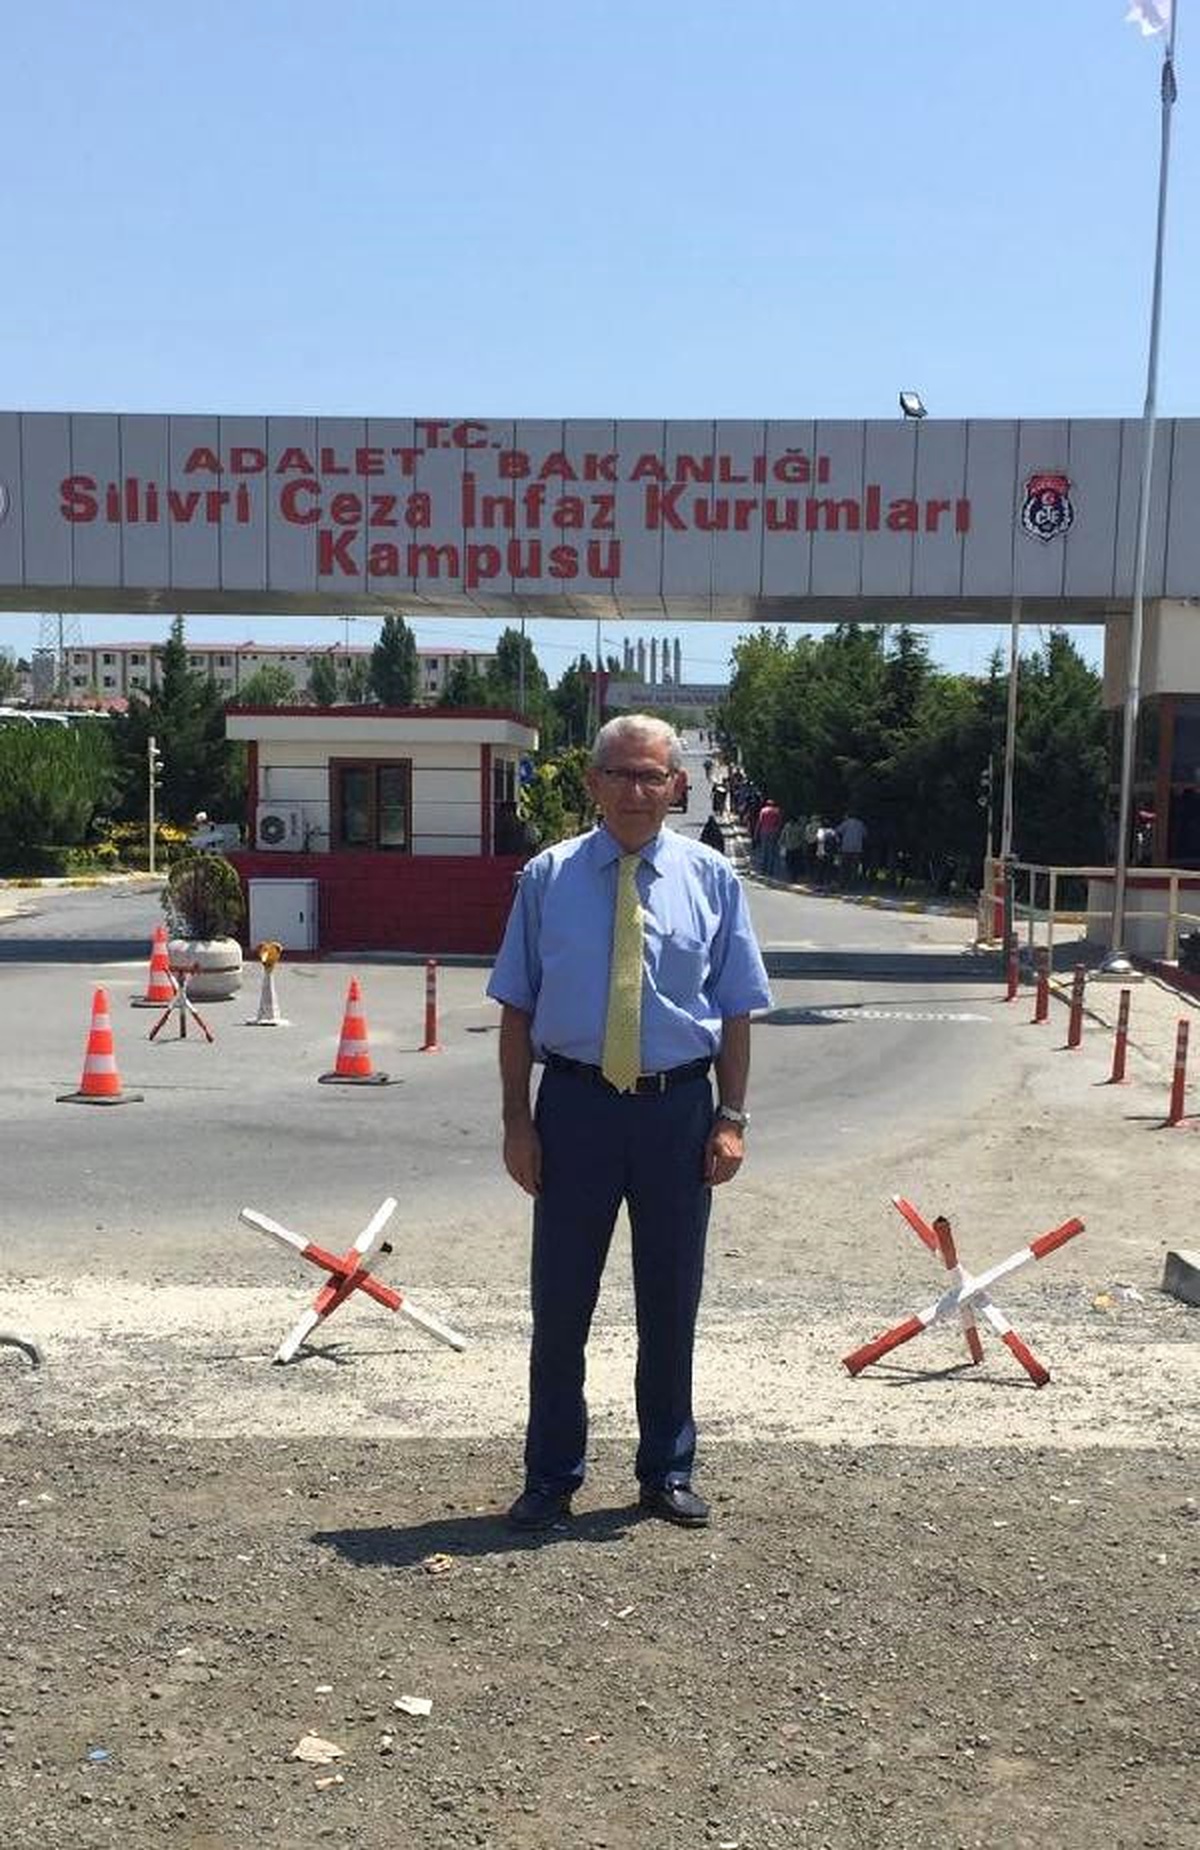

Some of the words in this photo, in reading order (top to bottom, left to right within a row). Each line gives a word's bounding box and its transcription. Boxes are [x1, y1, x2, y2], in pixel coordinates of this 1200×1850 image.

[415, 421, 502, 449] T.C.
[184, 447, 425, 477] ADALET
[498, 448, 831, 484] BAKANLIĞI
[59, 475, 251, 524] Silivri
[280, 478, 431, 528] Ceza
[461, 472, 617, 529] İnfaz
[645, 484, 971, 534] Kurumları
[318, 529, 621, 589] Kampüsü
